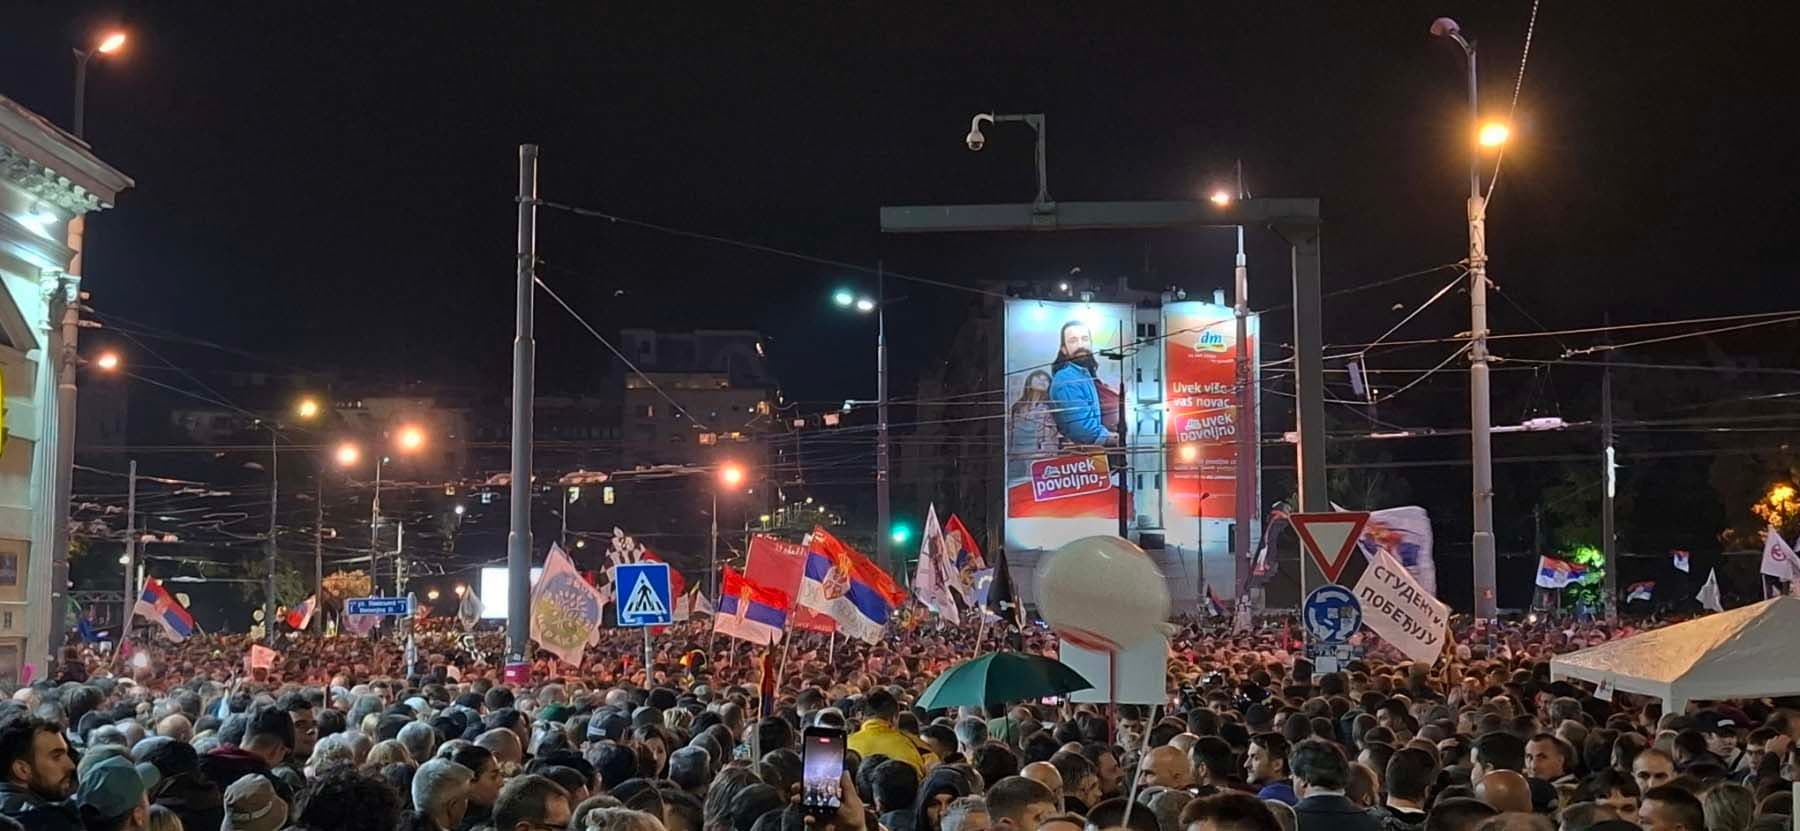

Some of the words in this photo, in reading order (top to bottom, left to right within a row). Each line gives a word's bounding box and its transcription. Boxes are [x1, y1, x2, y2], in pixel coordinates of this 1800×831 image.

[1201, 332, 1222, 344] dm
[1172, 382, 1202, 393] Uvek
[1202, 413, 1234, 428] uvek
[1061, 459, 1096, 474] uvek
[1361, 586, 1438, 646] ПОБЕЂУЈУ
